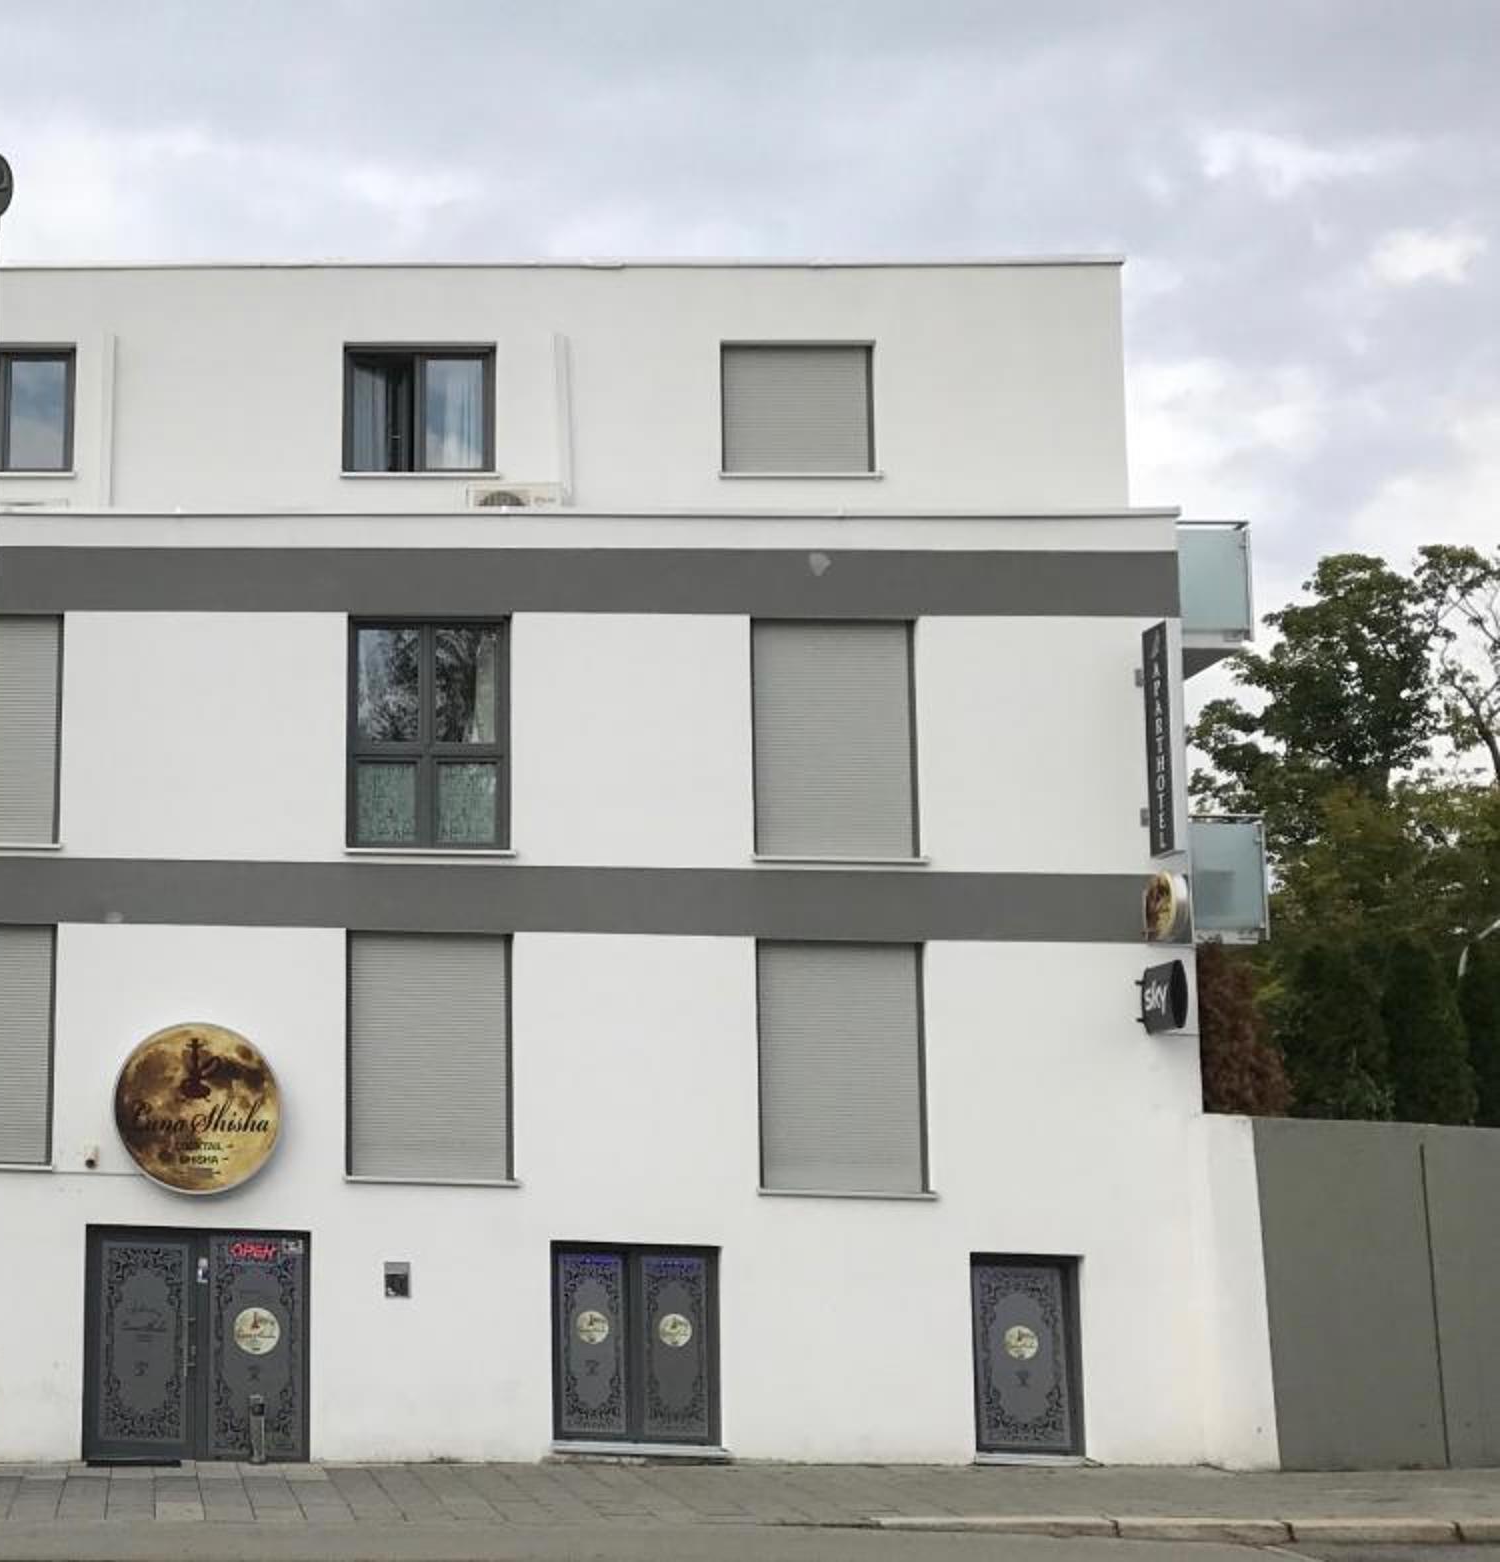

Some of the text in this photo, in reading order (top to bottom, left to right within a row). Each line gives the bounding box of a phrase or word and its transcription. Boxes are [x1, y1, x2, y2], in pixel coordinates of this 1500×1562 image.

[1152, 661, 1167, 850] APARTHOTEL
[1144, 979, 1169, 1016] sky
[191, 1099, 269, 1134] Shisha
[179, 1154, 219, 1165] SHISHA
[229, 1242, 277, 1261] OPEN
